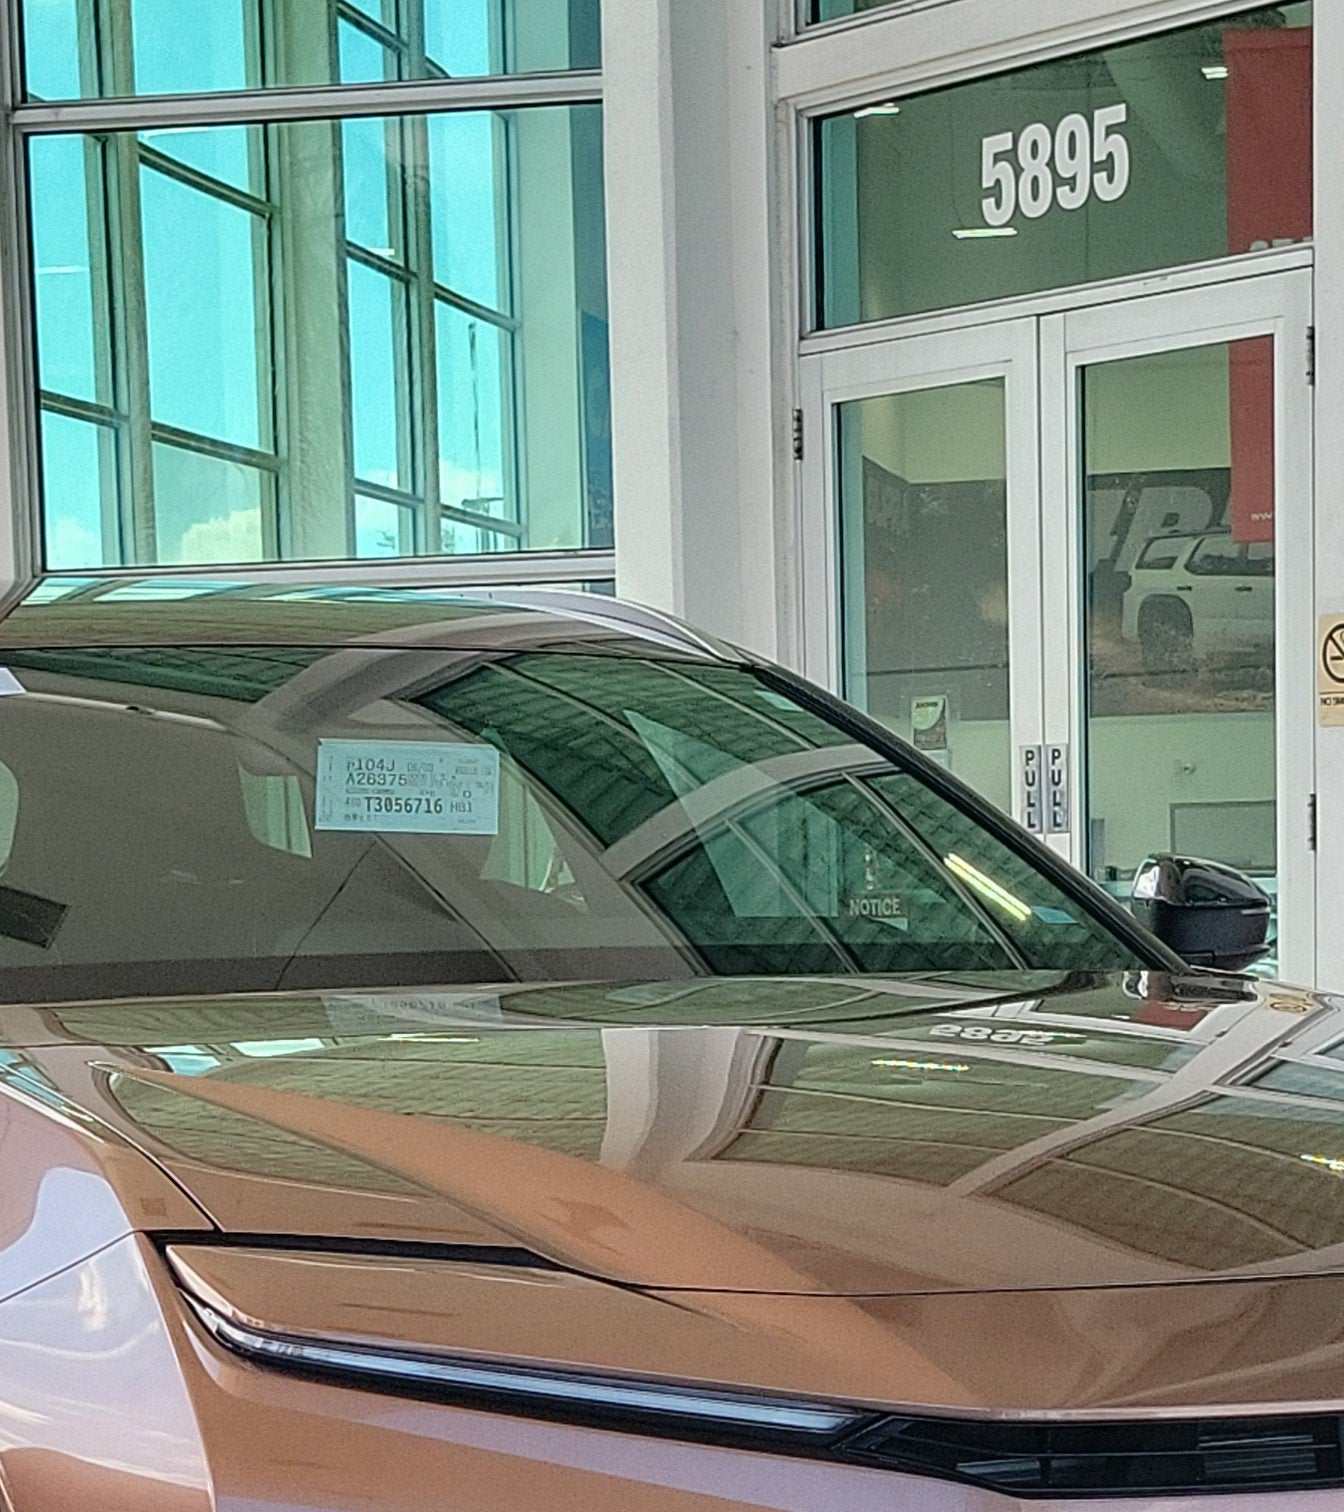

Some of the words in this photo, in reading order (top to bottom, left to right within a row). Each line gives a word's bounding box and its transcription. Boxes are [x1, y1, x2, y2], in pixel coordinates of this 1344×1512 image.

[982, 103, 1130, 227] 5895
[1320, 697, 1332, 706] NO
[365, 797, 443, 814] T3056716
[1025, 750, 1036, 828] PULL
[1051, 748, 1062, 828] PULL
[849, 898, 901, 916] NOTICE
